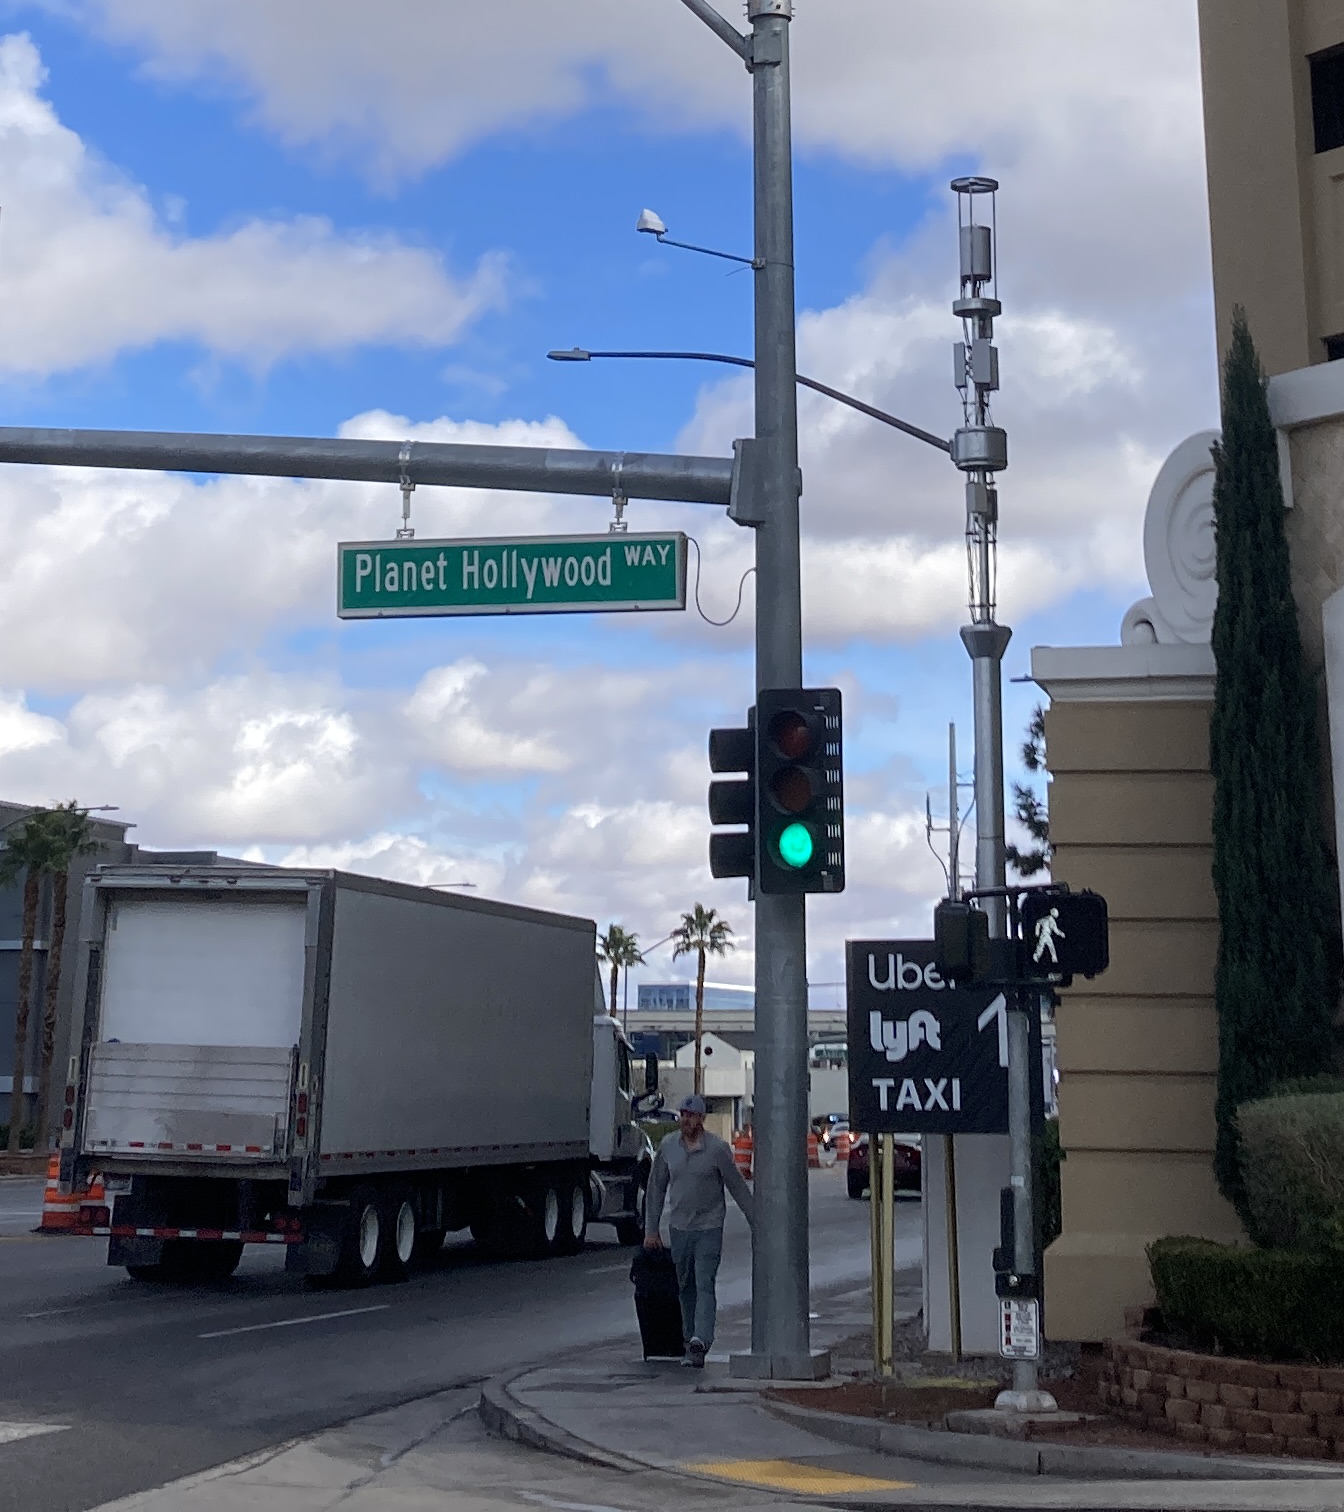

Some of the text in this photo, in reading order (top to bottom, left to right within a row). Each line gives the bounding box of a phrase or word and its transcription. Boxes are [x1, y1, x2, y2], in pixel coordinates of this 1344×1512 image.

[356, 544, 671, 599] Planet Hollywood WAY
[867, 953, 957, 990] Ube
[869, 1009, 942, 1063] lyft
[872, 1078, 962, 1112] TAXI
